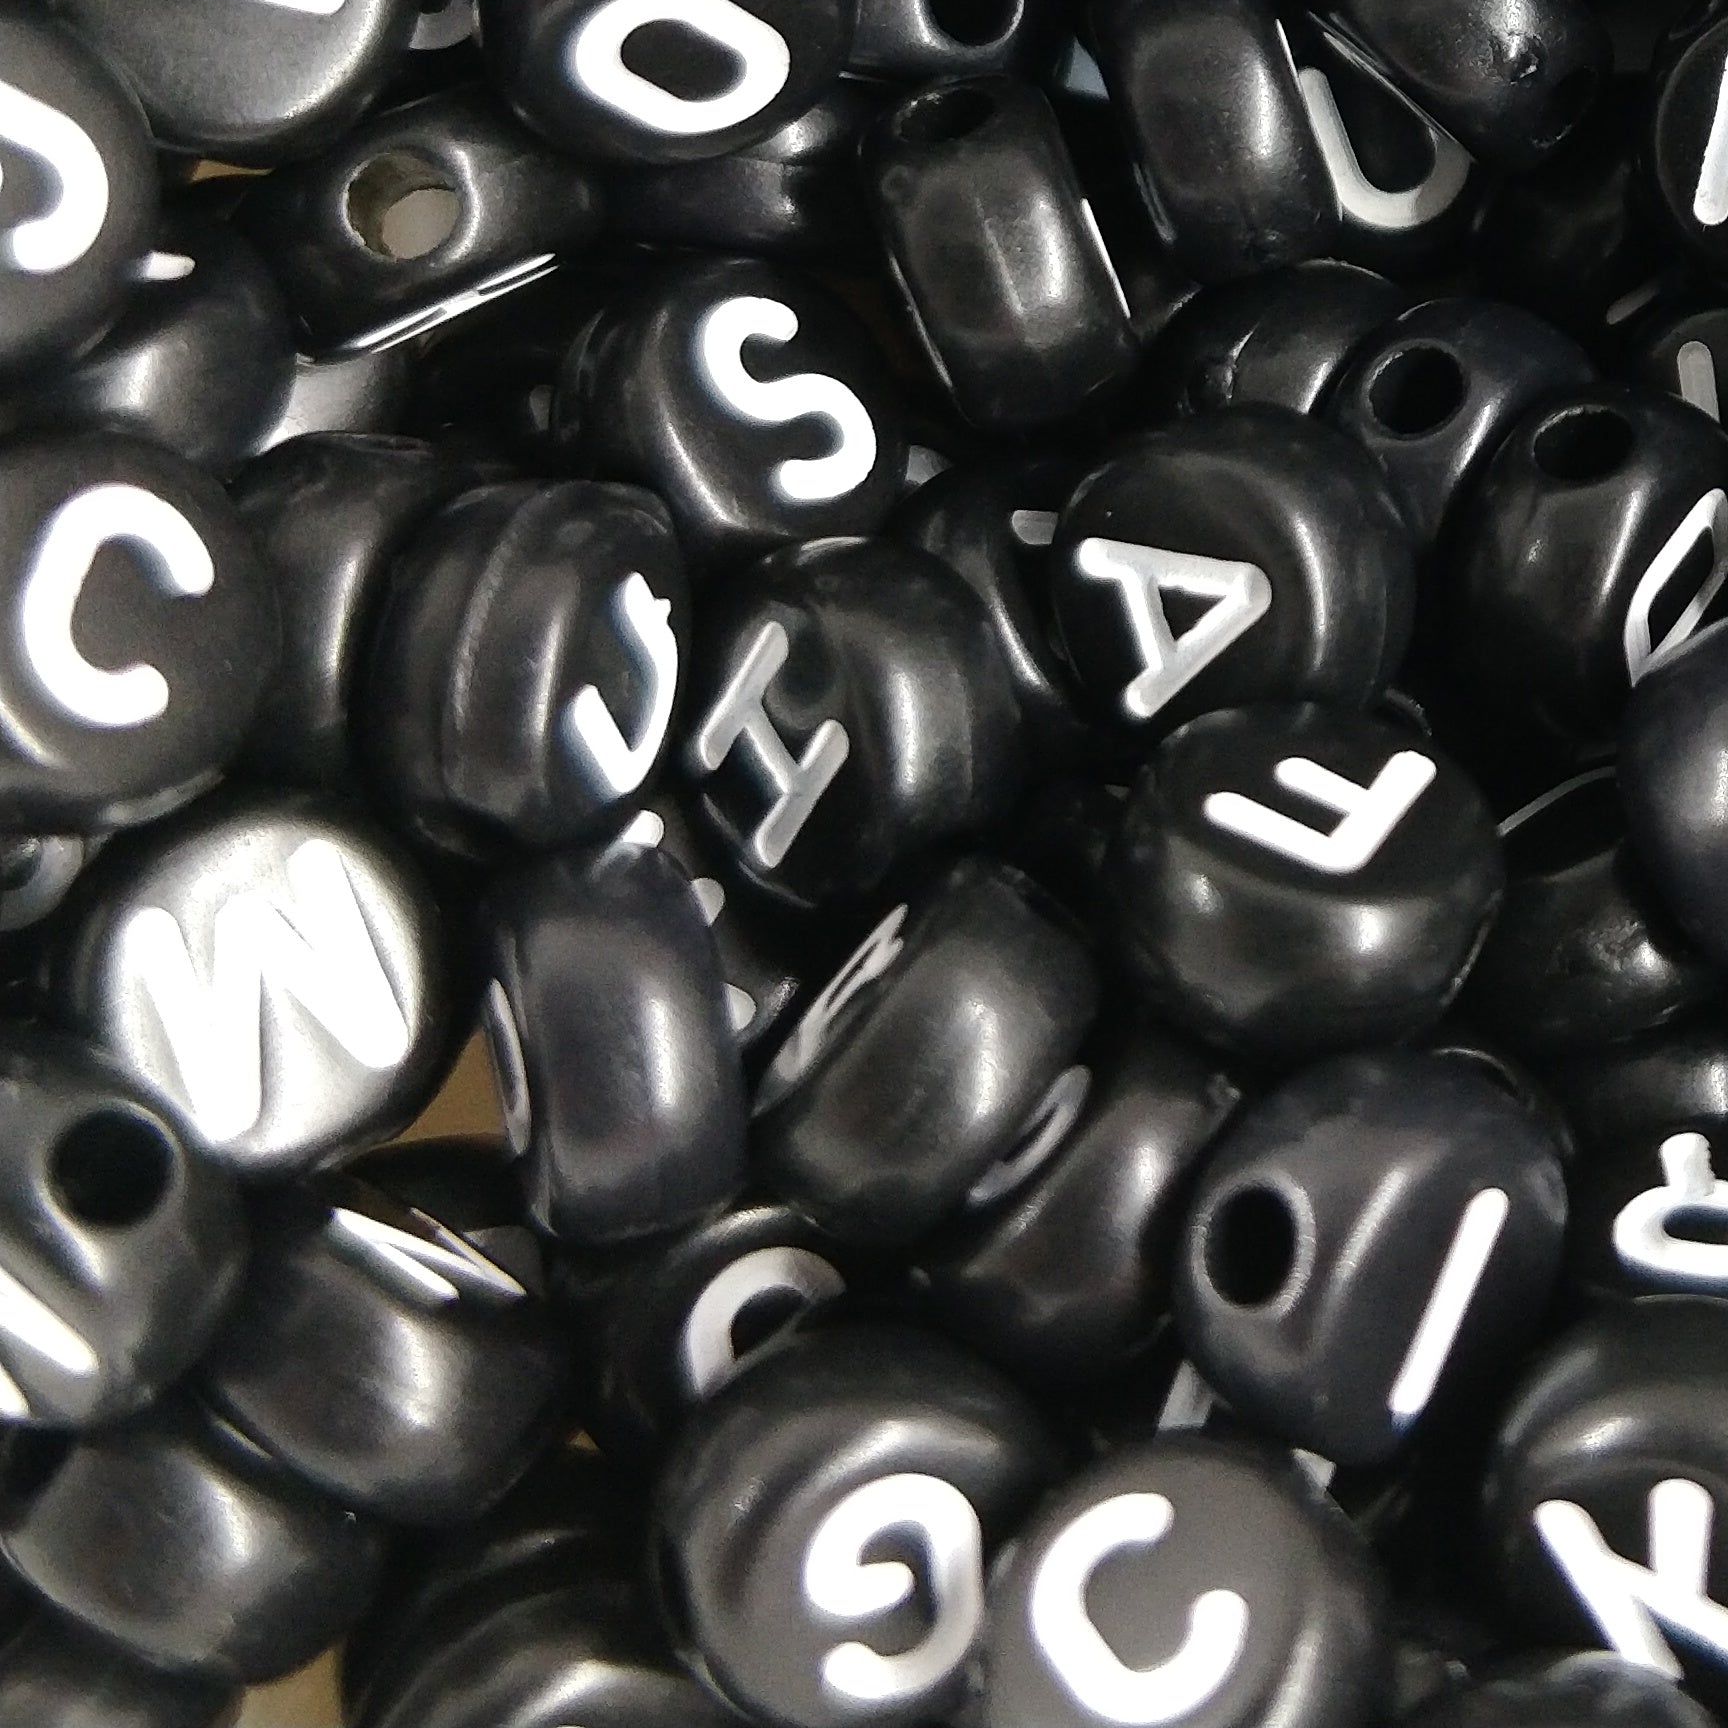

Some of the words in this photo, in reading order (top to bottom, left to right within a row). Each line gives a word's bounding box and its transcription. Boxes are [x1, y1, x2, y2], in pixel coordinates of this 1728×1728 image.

[697, 297, 876, 500] S
[22, 484, 213, 726] C
[1077, 540, 1271, 718] A
[698, 622, 848, 868] H
[1206, 752, 1436, 872] F
[1393, 1188, 1509, 1419] I
[1032, 1494, 1247, 1726] C
